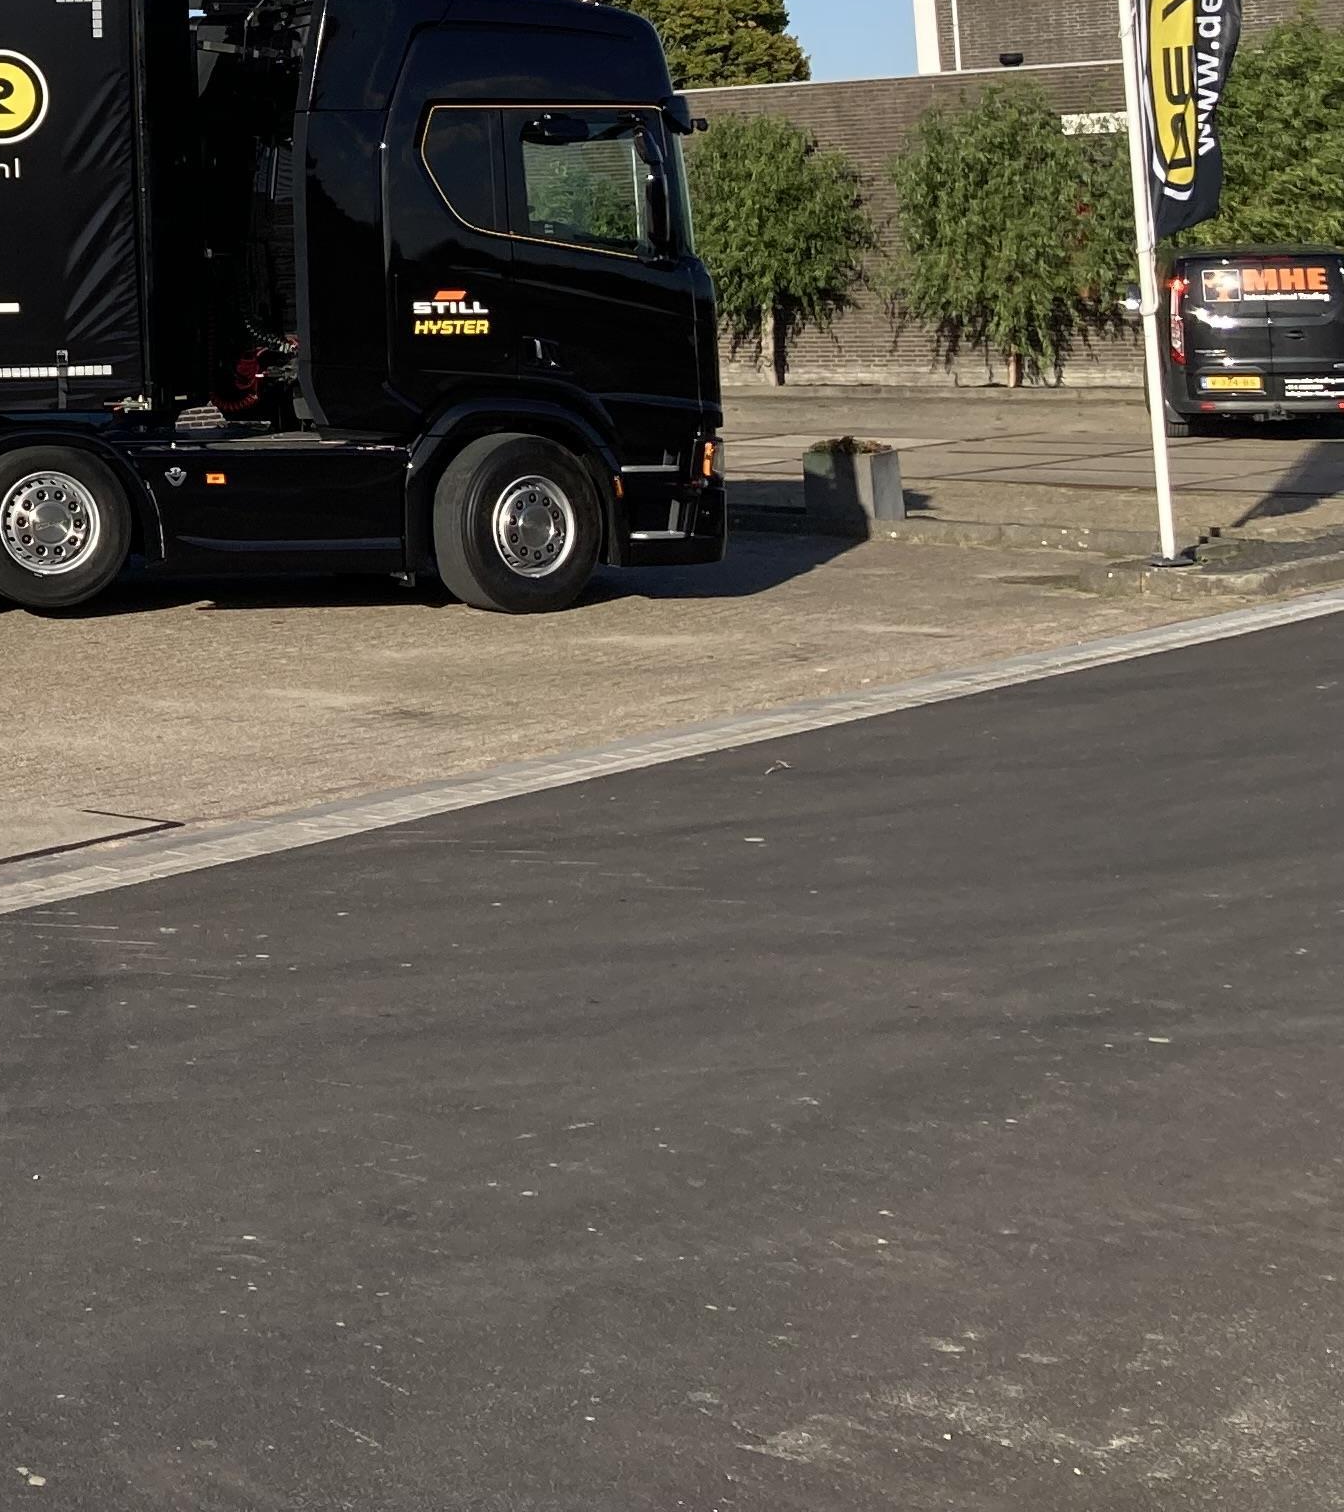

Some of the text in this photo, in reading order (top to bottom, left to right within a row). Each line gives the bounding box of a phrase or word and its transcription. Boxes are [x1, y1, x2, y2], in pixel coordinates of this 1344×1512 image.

[1161, 45, 1194, 169] DE
[1242, 268, 1329, 291] MHE
[412, 300, 489, 314] STILL
[414, 320, 489, 335] HYSTER
